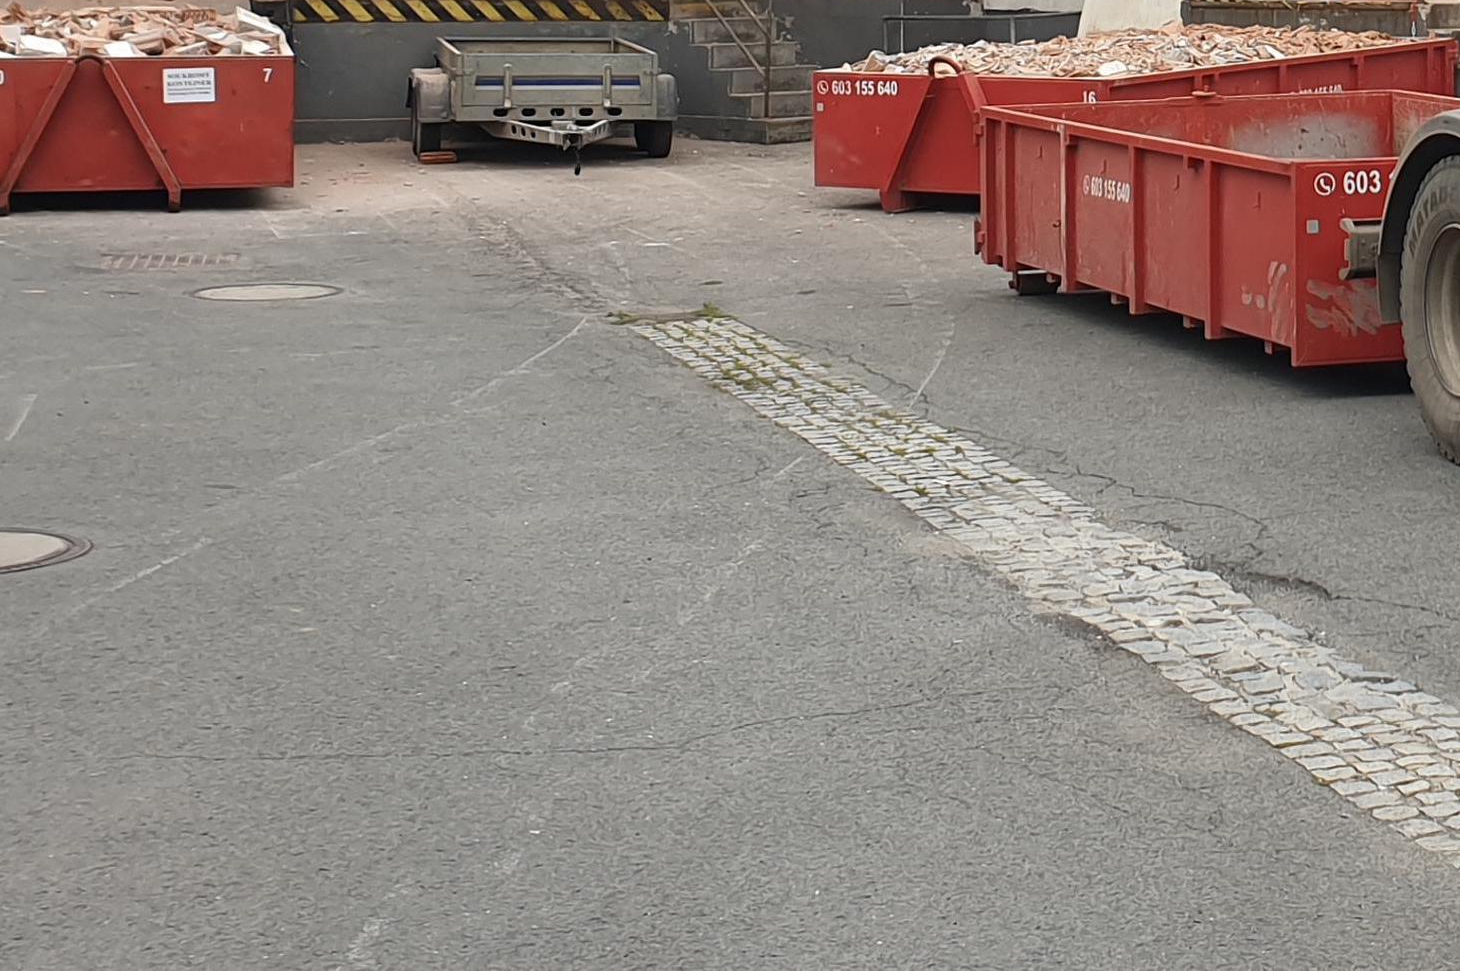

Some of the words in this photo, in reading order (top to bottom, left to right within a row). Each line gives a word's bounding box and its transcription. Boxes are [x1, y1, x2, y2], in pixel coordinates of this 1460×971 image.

[262, 68, 272, 83] 7
[831, 80, 852, 96] 603
[854, 81, 875, 96] 155
[877, 81, 898, 96] 640
[1083, 90, 1096, 103] 16
[1091, 176, 1103, 198] 603
[1104, 179, 1115, 200] 155
[1117, 181, 1131, 203] 640
[1342, 169, 1382, 195] 603
